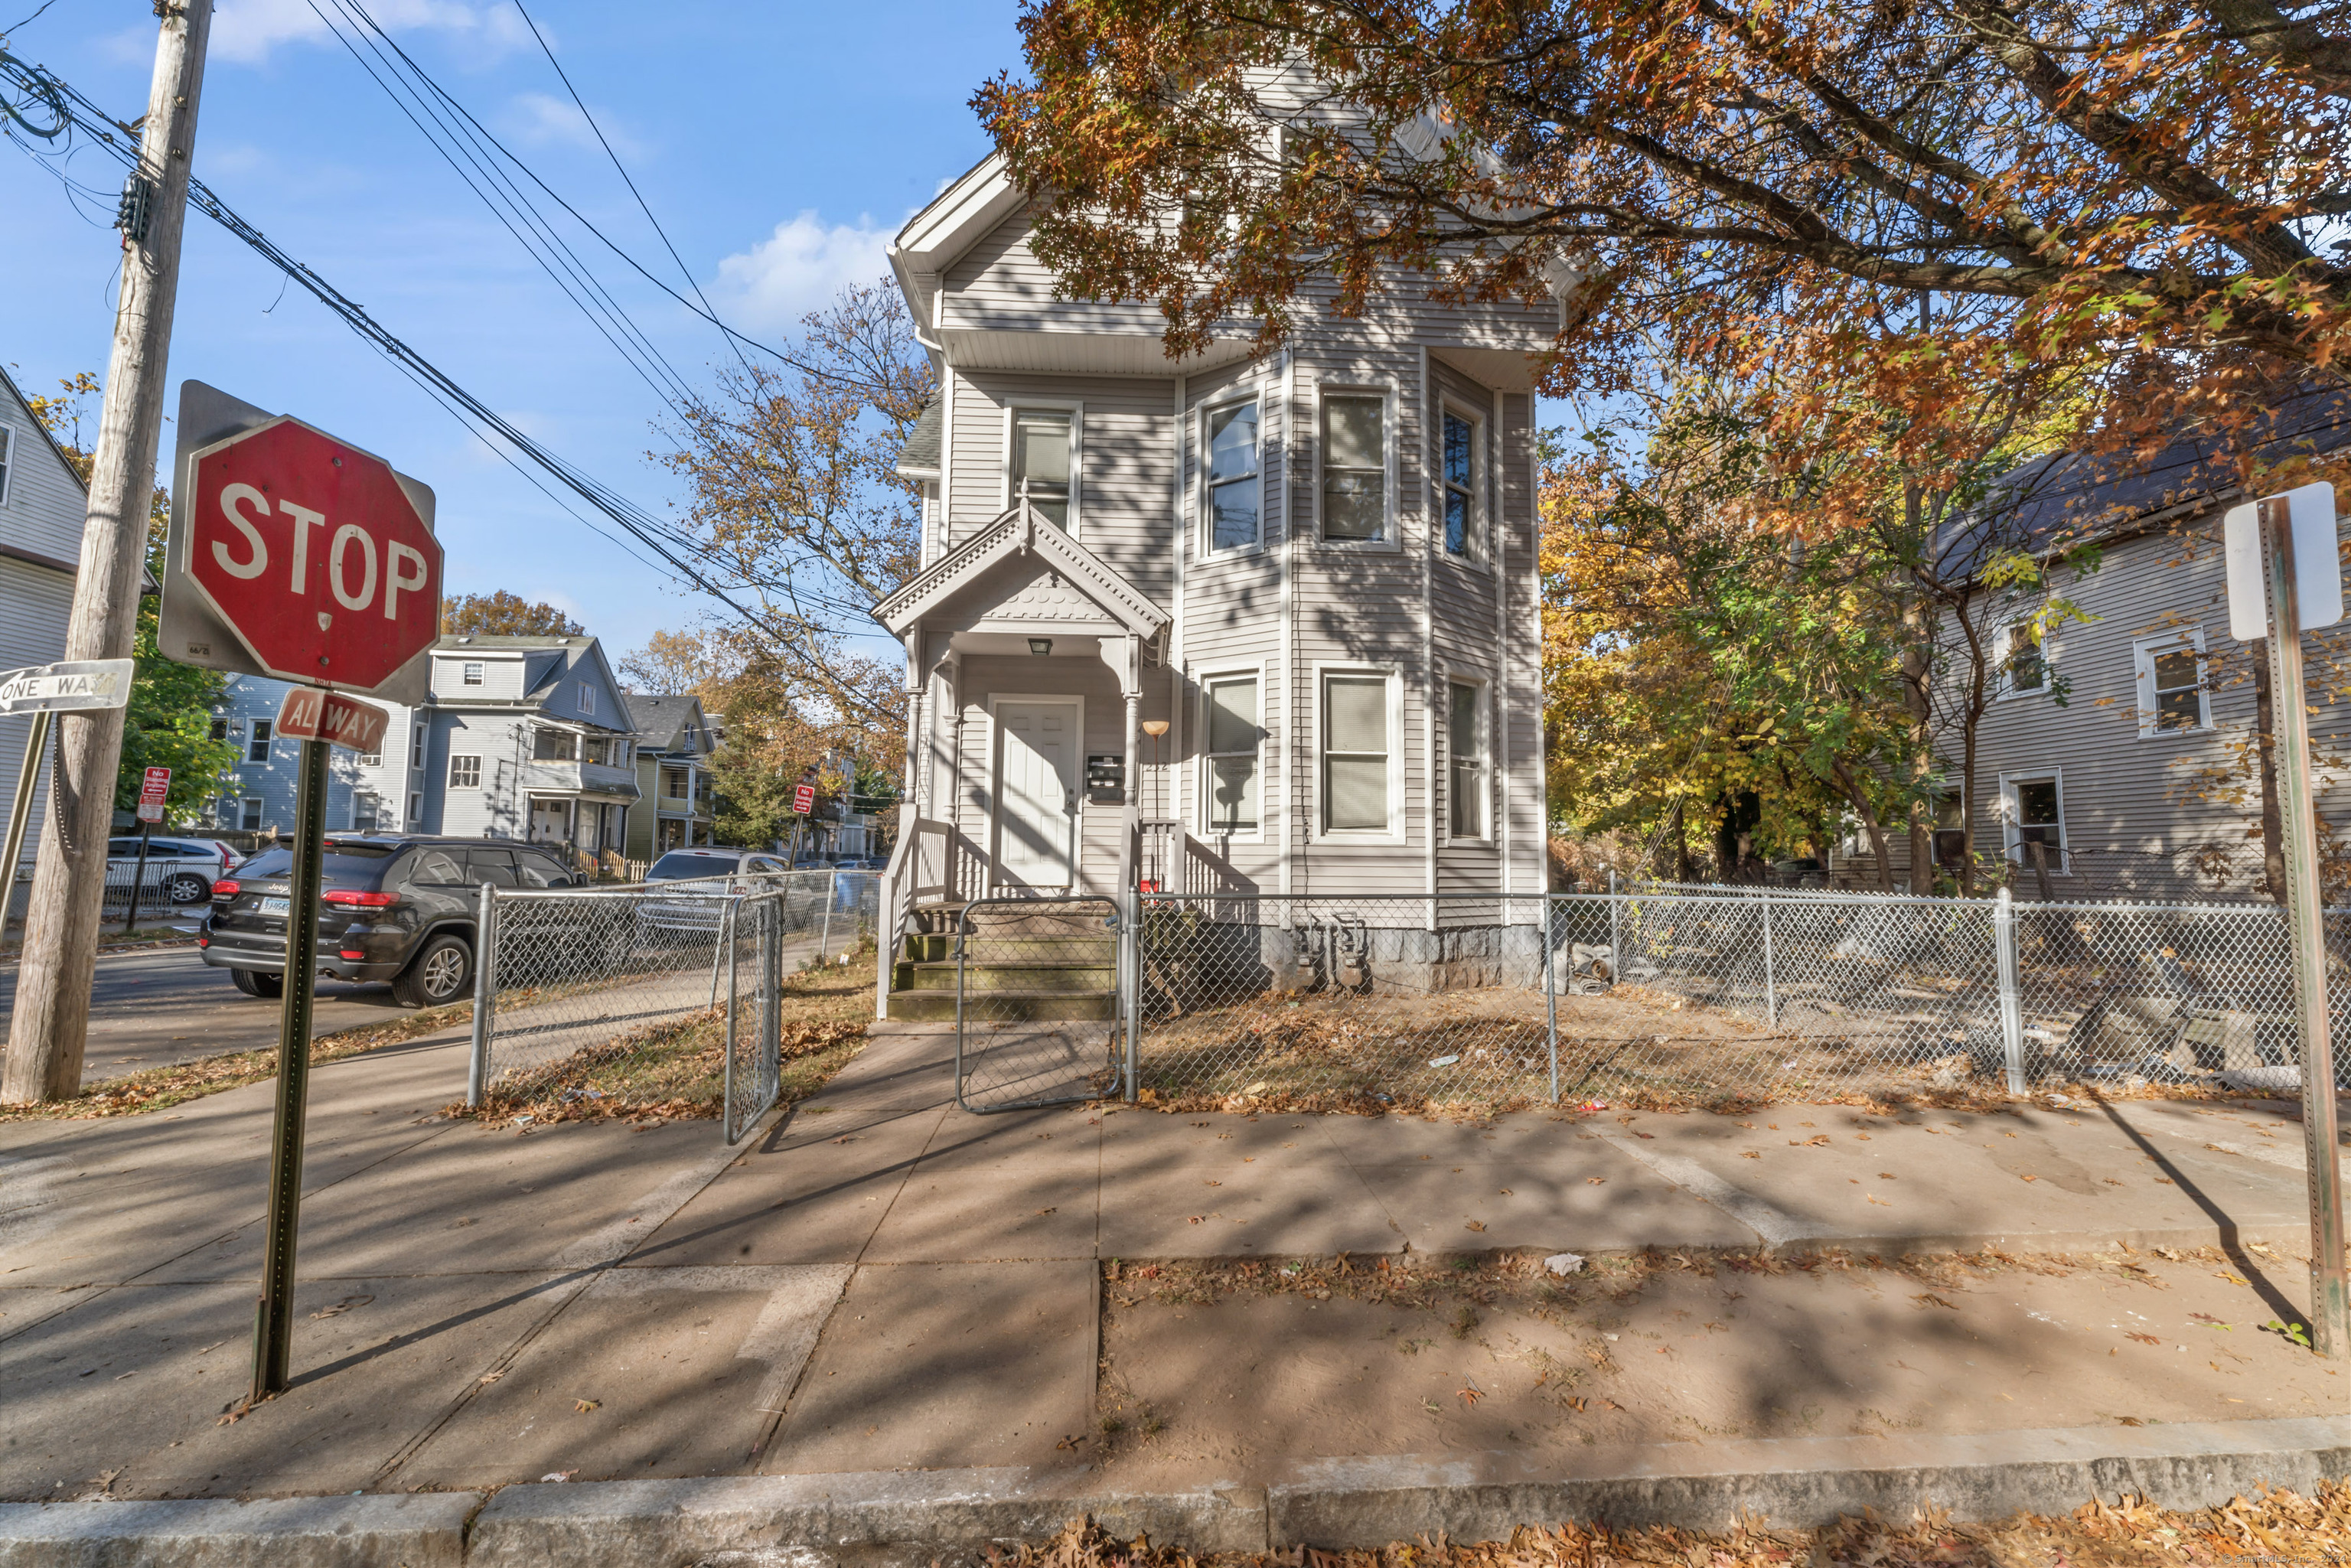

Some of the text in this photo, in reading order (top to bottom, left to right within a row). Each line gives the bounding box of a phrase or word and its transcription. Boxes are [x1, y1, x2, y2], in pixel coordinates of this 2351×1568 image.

[212, 482, 428, 621] STOP
[2, 674, 105, 700] ONE WAY
[325, 703, 377, 742] WAY
[269, 883, 289, 893] Jeep
